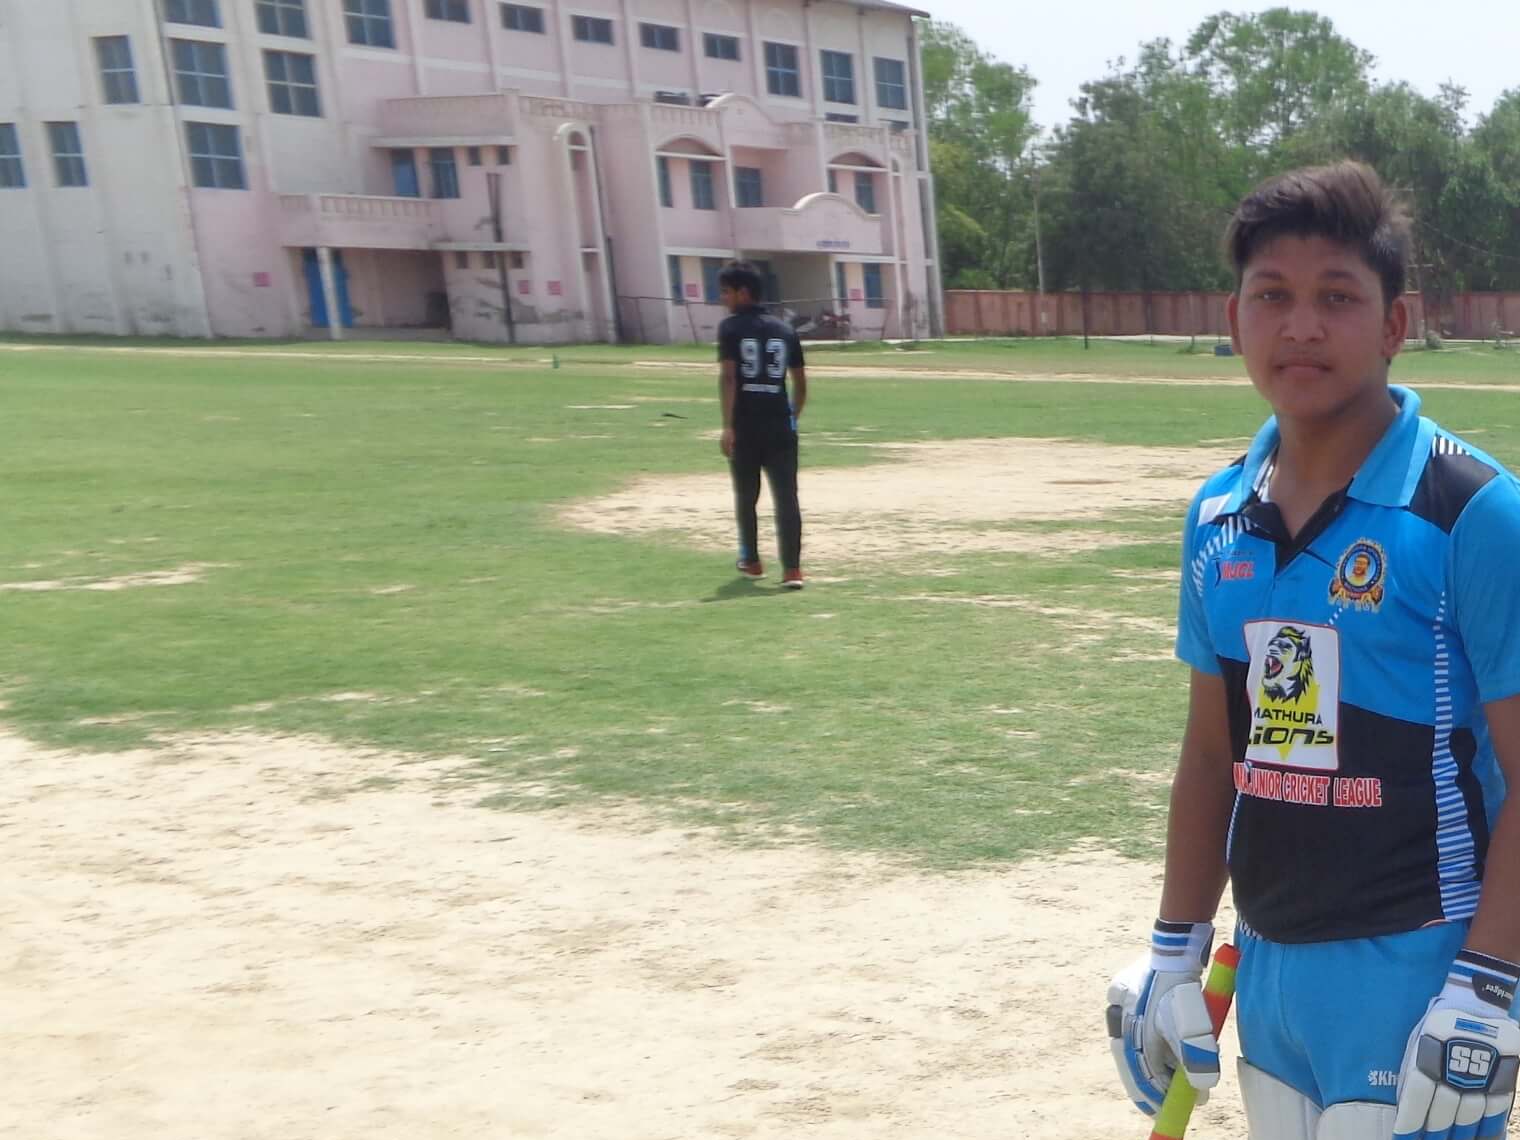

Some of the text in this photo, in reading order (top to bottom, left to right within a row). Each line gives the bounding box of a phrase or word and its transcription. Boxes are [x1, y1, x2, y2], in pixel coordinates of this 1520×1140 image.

[740, 337, 786, 379] 93
[1250, 768, 1281, 801] JUNIOR
[1283, 773, 1330, 806] CRICKET
[1333, 777, 1382, 807] LEAGUE
[1448, 1045, 1492, 1076] SS
